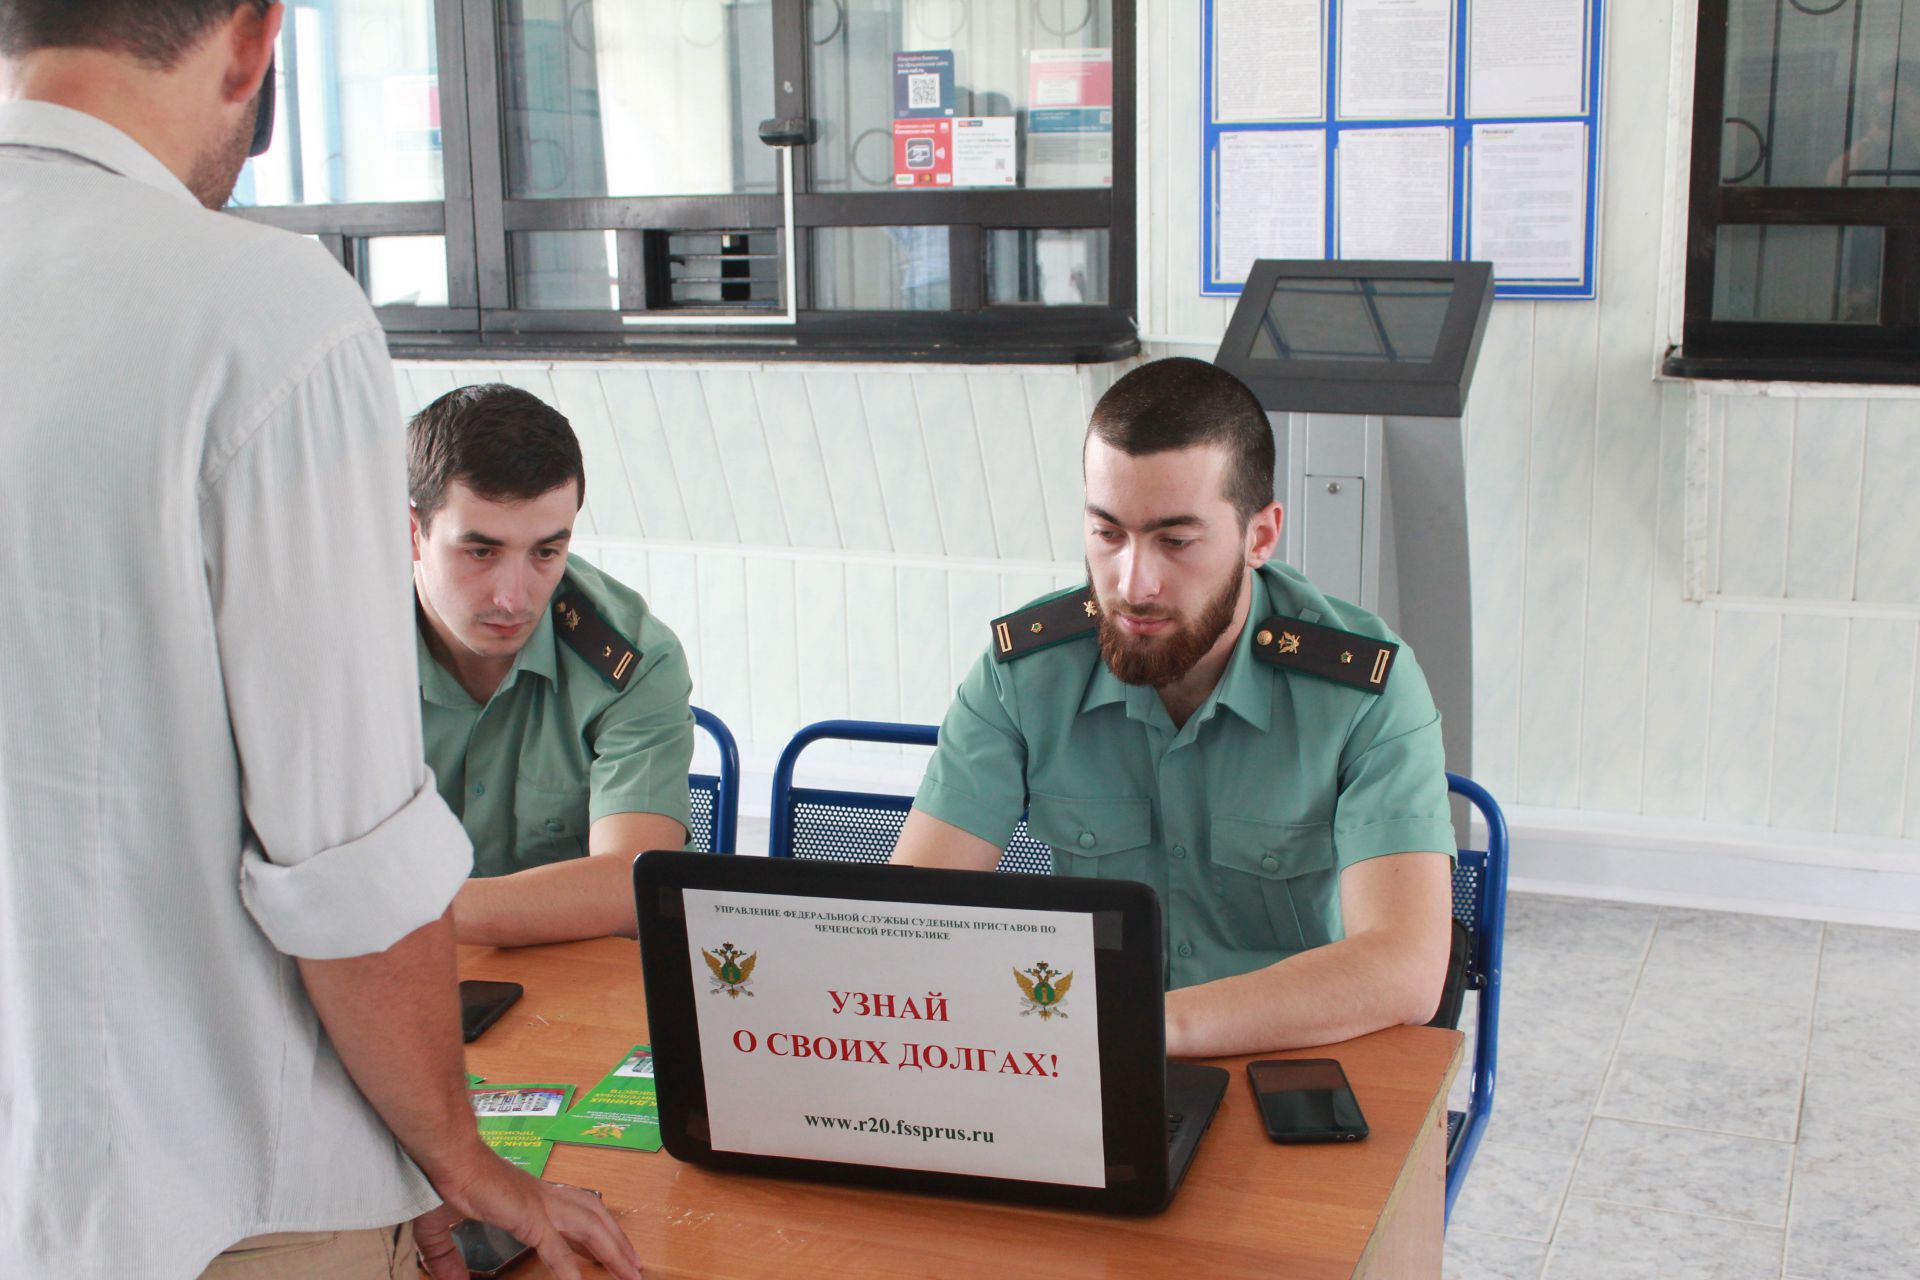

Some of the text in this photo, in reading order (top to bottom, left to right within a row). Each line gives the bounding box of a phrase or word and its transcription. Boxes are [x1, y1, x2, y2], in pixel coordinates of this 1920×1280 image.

[714, 904, 1056, 934] УПРАВЛЕНИЕ ФЕДЕРАЛЬНОЙ СЛУЖБЫ СУДЕБНЫХ ПРИСТАВОВ ПО
[814, 924, 951, 940] ЧЕЧЕНСКОЙ РЕСПУБЛИКЕ
[827, 990, 949, 1022] УЗНАЙ
[732, 1029, 1059, 1078] О СВОИХ ДОЛГАХ!
[804, 1114, 994, 1144] www.r20.fssprus.ru
